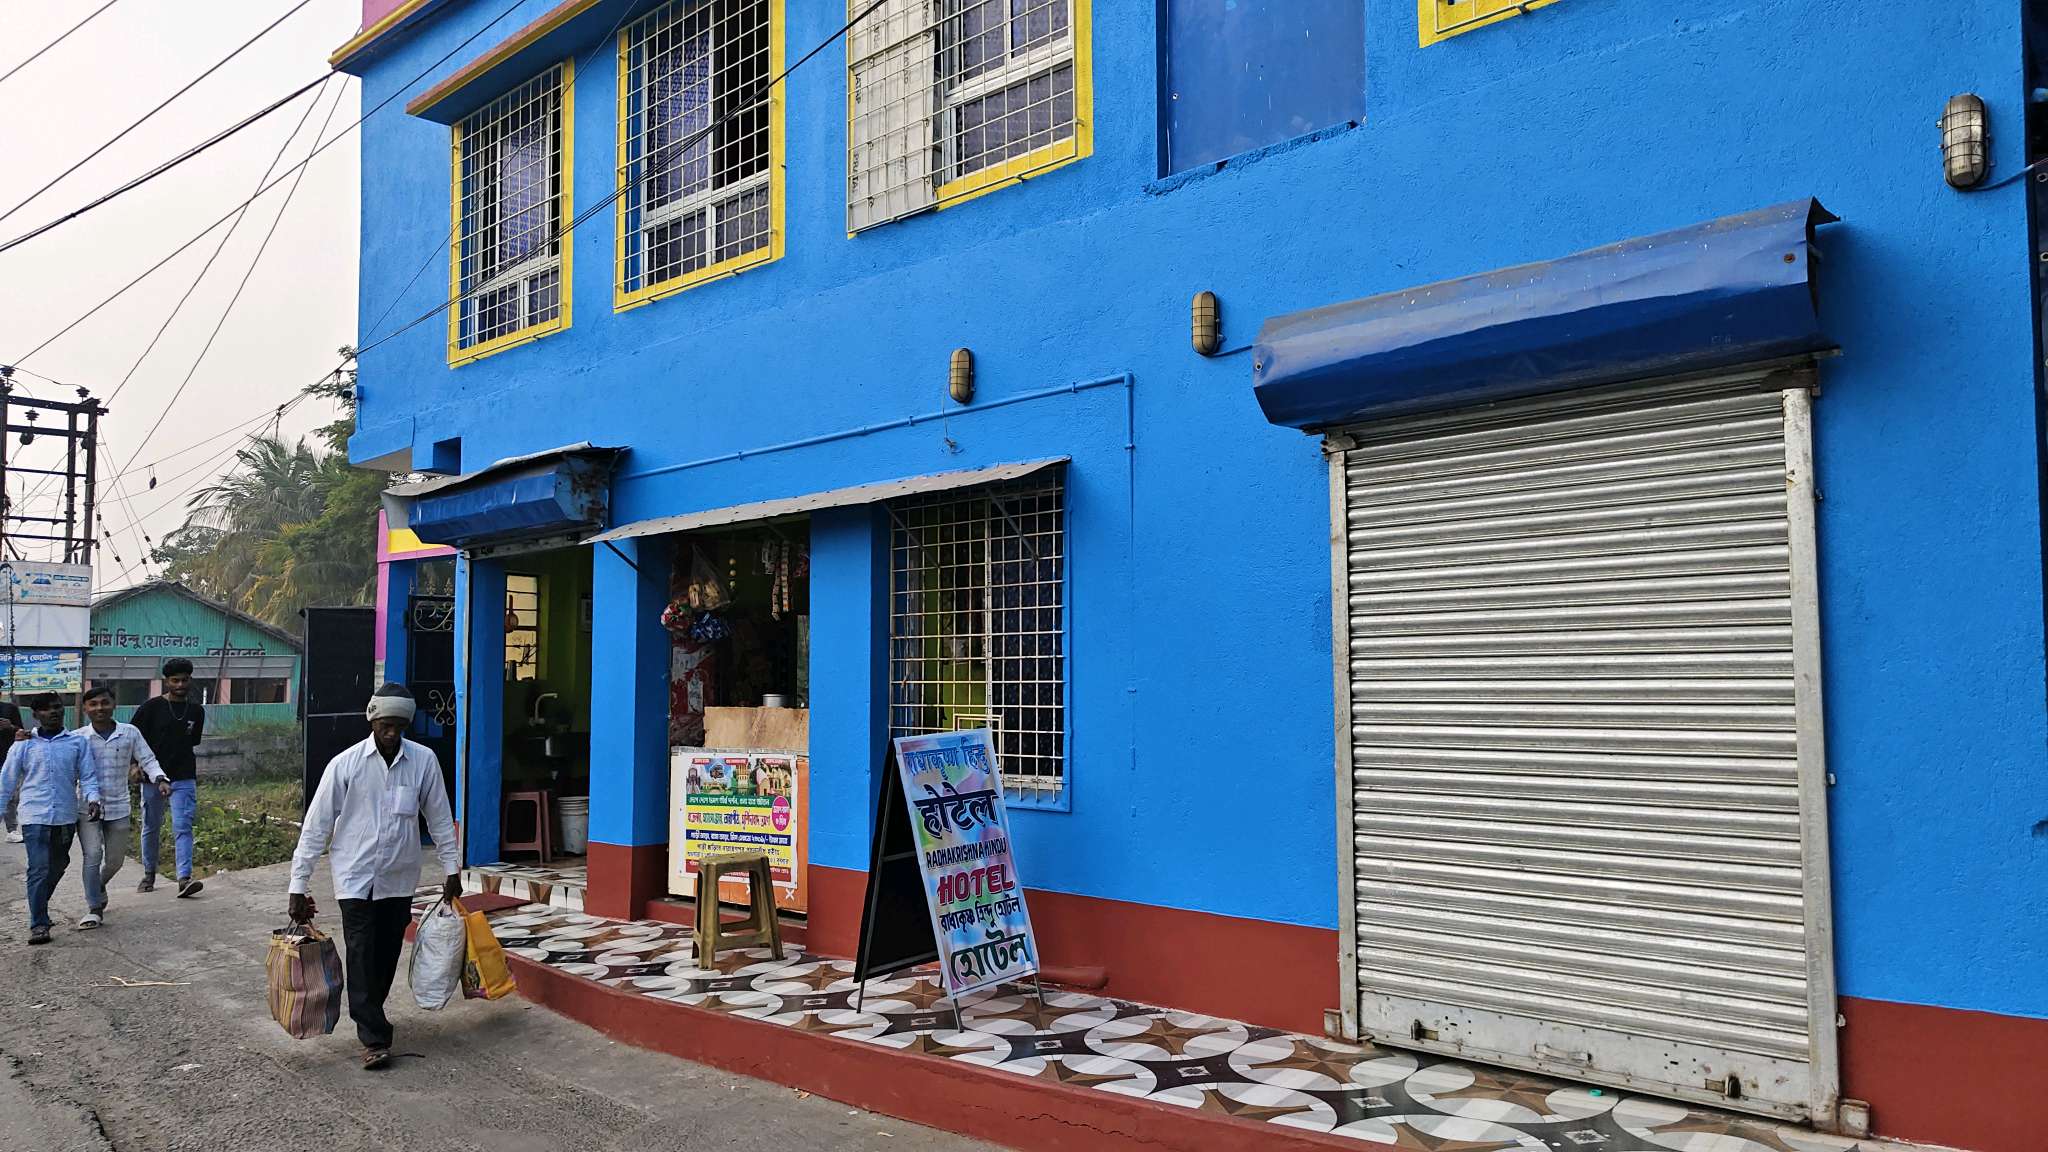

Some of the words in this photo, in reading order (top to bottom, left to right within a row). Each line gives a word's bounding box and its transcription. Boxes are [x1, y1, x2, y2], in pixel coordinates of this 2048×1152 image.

[144, 630, 183, 648] হোটেল
[913, 782, 1000, 839] होटेल
[925, 842, 985, 869] RADHAKRISHNA
[985, 837, 1008, 857] HINDU
[937, 864, 1015, 906] HOTEL
[995, 893, 1022, 917] হোটেল
[951, 928, 1031, 986] হোটেল
